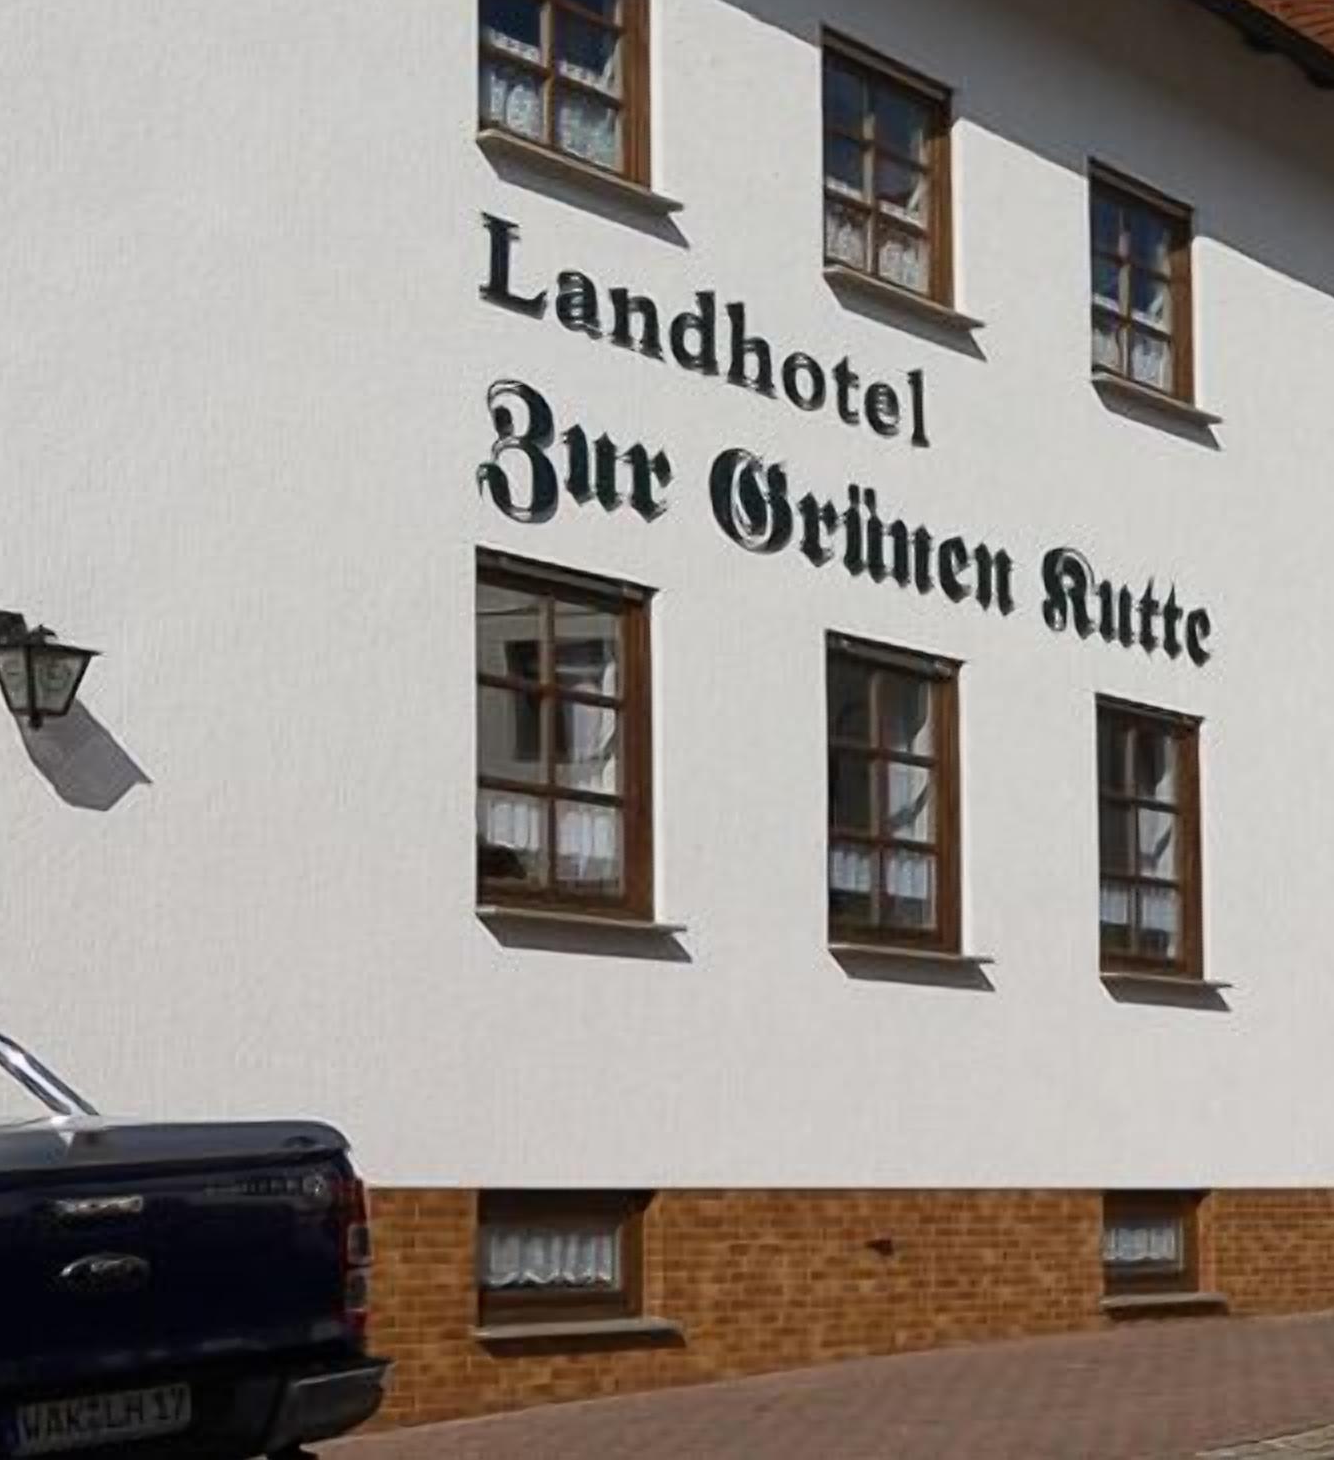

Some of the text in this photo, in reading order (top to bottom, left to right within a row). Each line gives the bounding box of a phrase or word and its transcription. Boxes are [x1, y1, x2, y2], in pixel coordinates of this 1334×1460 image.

[479, 210, 931, 449] Landhotel
[475, 378, 1213, 667] Zur Grünen Kutte
